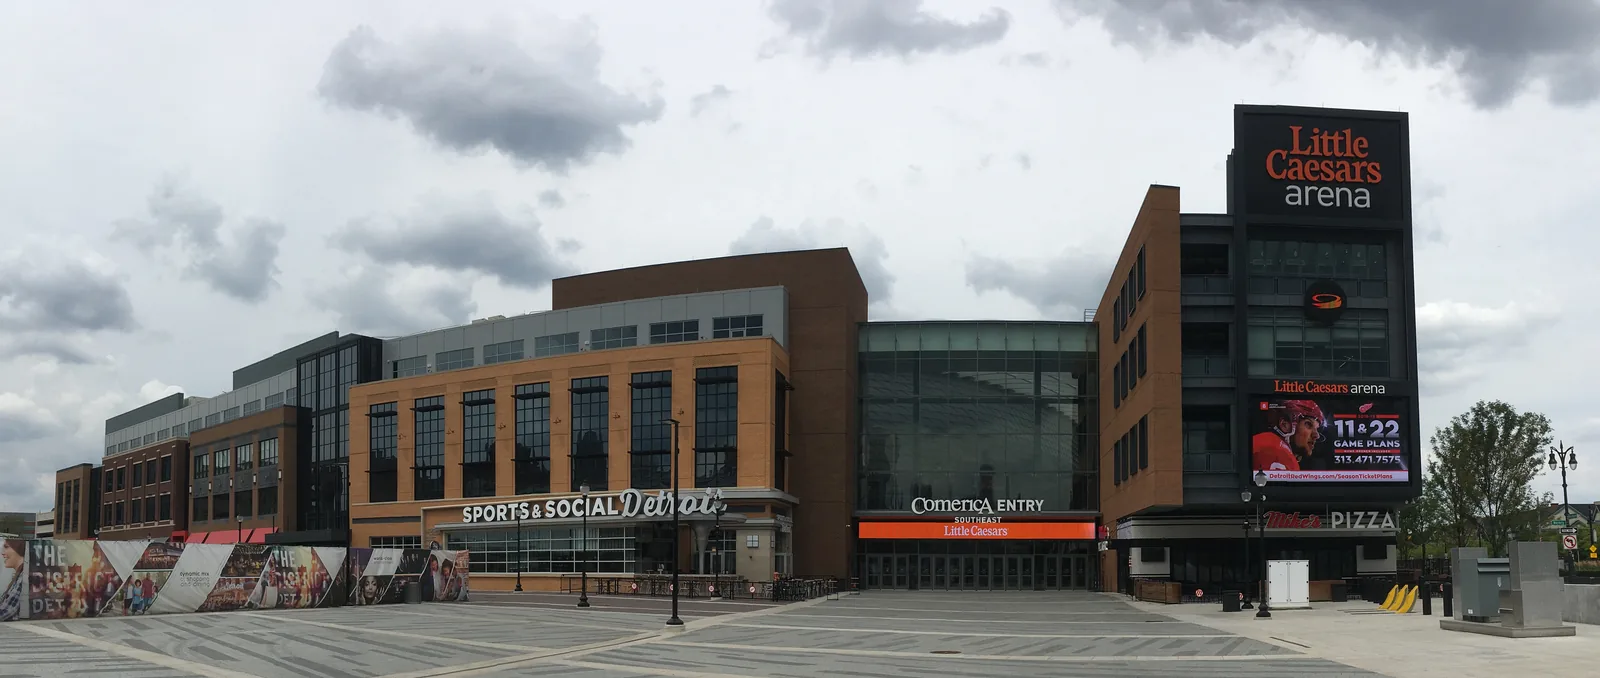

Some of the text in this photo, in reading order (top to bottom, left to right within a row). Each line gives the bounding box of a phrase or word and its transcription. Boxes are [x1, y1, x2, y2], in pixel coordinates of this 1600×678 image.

[1289, 125, 1369, 159] Little
[1265, 149, 1382, 184] Caesars
[1285, 184, 1371, 208] arena
[1274, 379, 1386, 394] Little Caesars arena
[1333, 419, 1400, 438] 11 & 22
[1333, 440, 1401, 448] GAME PLANS
[1334, 455, 1401, 464] 313.471.7575
[462, 502, 530, 523] SPORTS
[531, 503, 542, 518] &
[545, 496, 619, 518] SOCIAL
[997, 499, 1045, 512] ENTRY
[954, 516, 1003, 524] SOUTHEAST
[1263, 510, 1396, 529] Mike's PIZZA
[943, 525, 1008, 537] Little Caesars
[32, 544, 67, 567] THE
